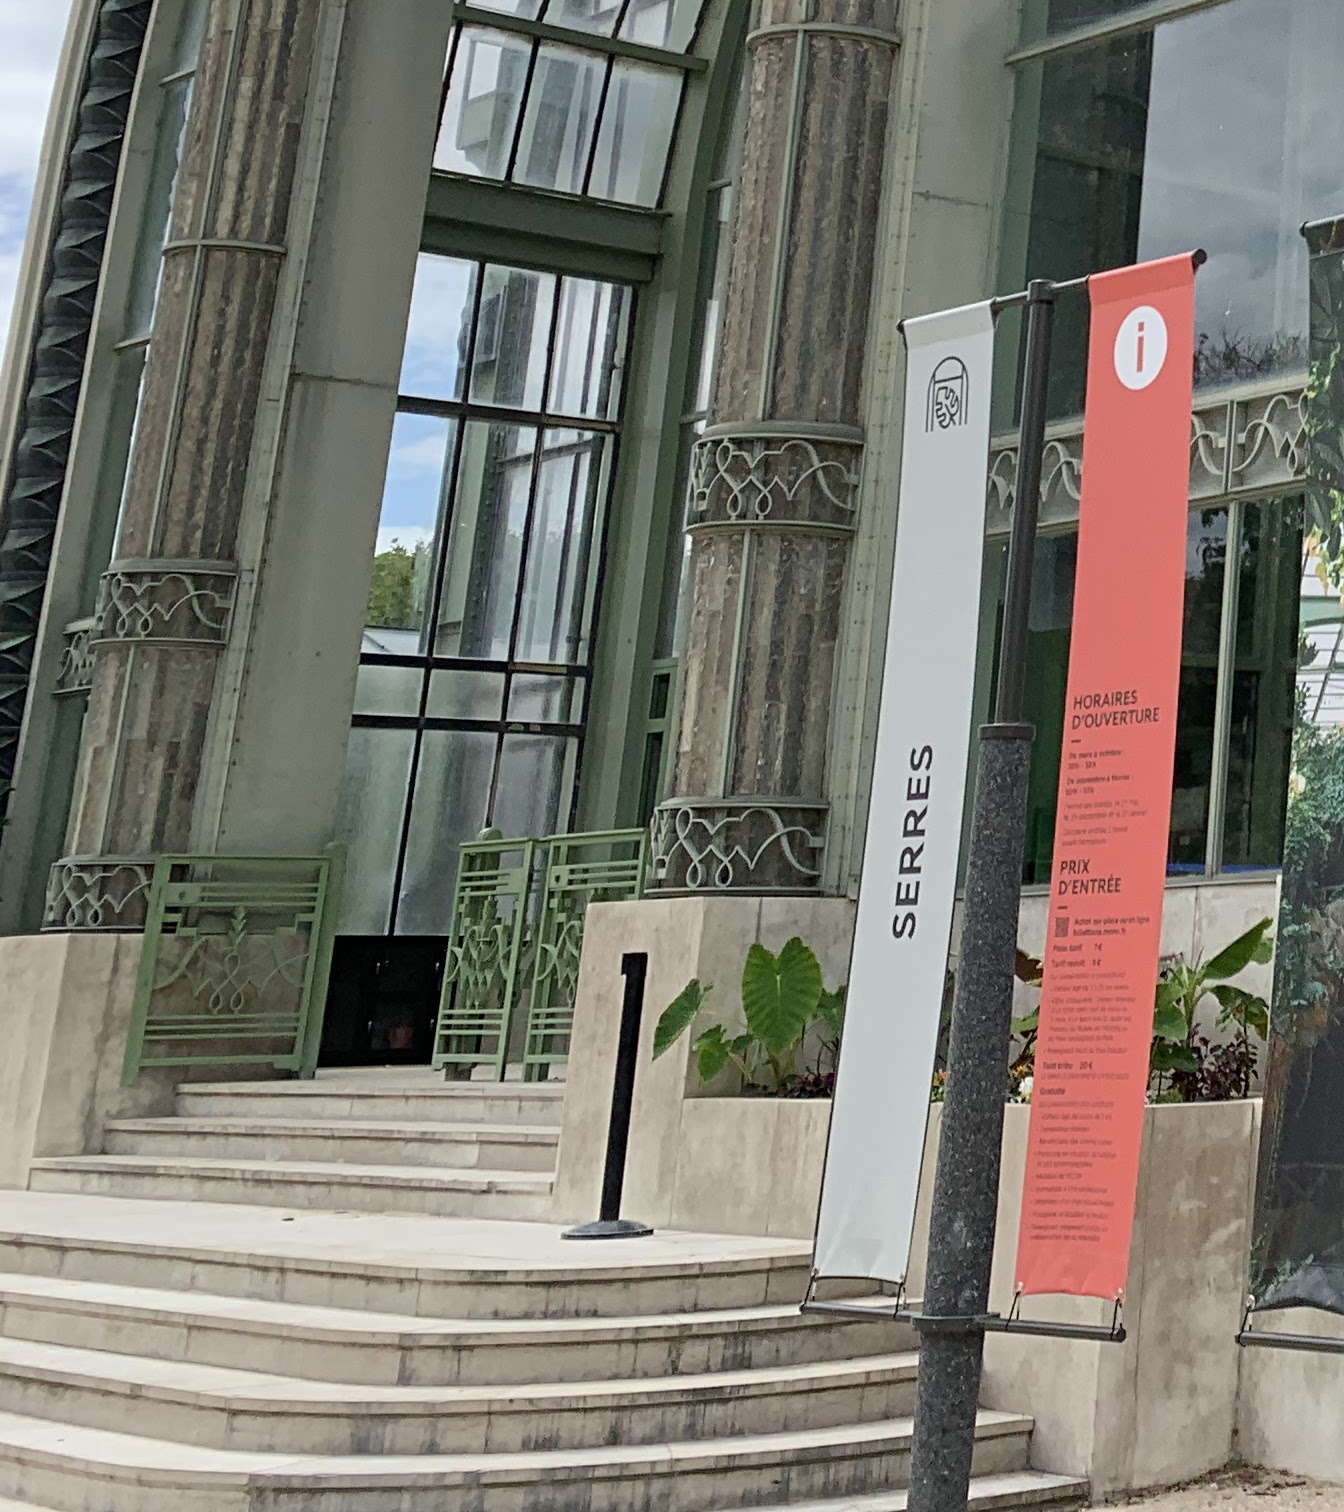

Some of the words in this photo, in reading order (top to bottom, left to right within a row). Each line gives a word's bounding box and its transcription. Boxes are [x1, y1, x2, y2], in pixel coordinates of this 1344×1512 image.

[1073, 689, 1138, 710] HORAIRES
[1071, 707, 1160, 730] D'OUVERTURE
[892, 744, 933, 940] SERRES
[1059, 858, 1090, 875] PRIX
[1058, 874, 1122, 896] D'ENTRÉE
